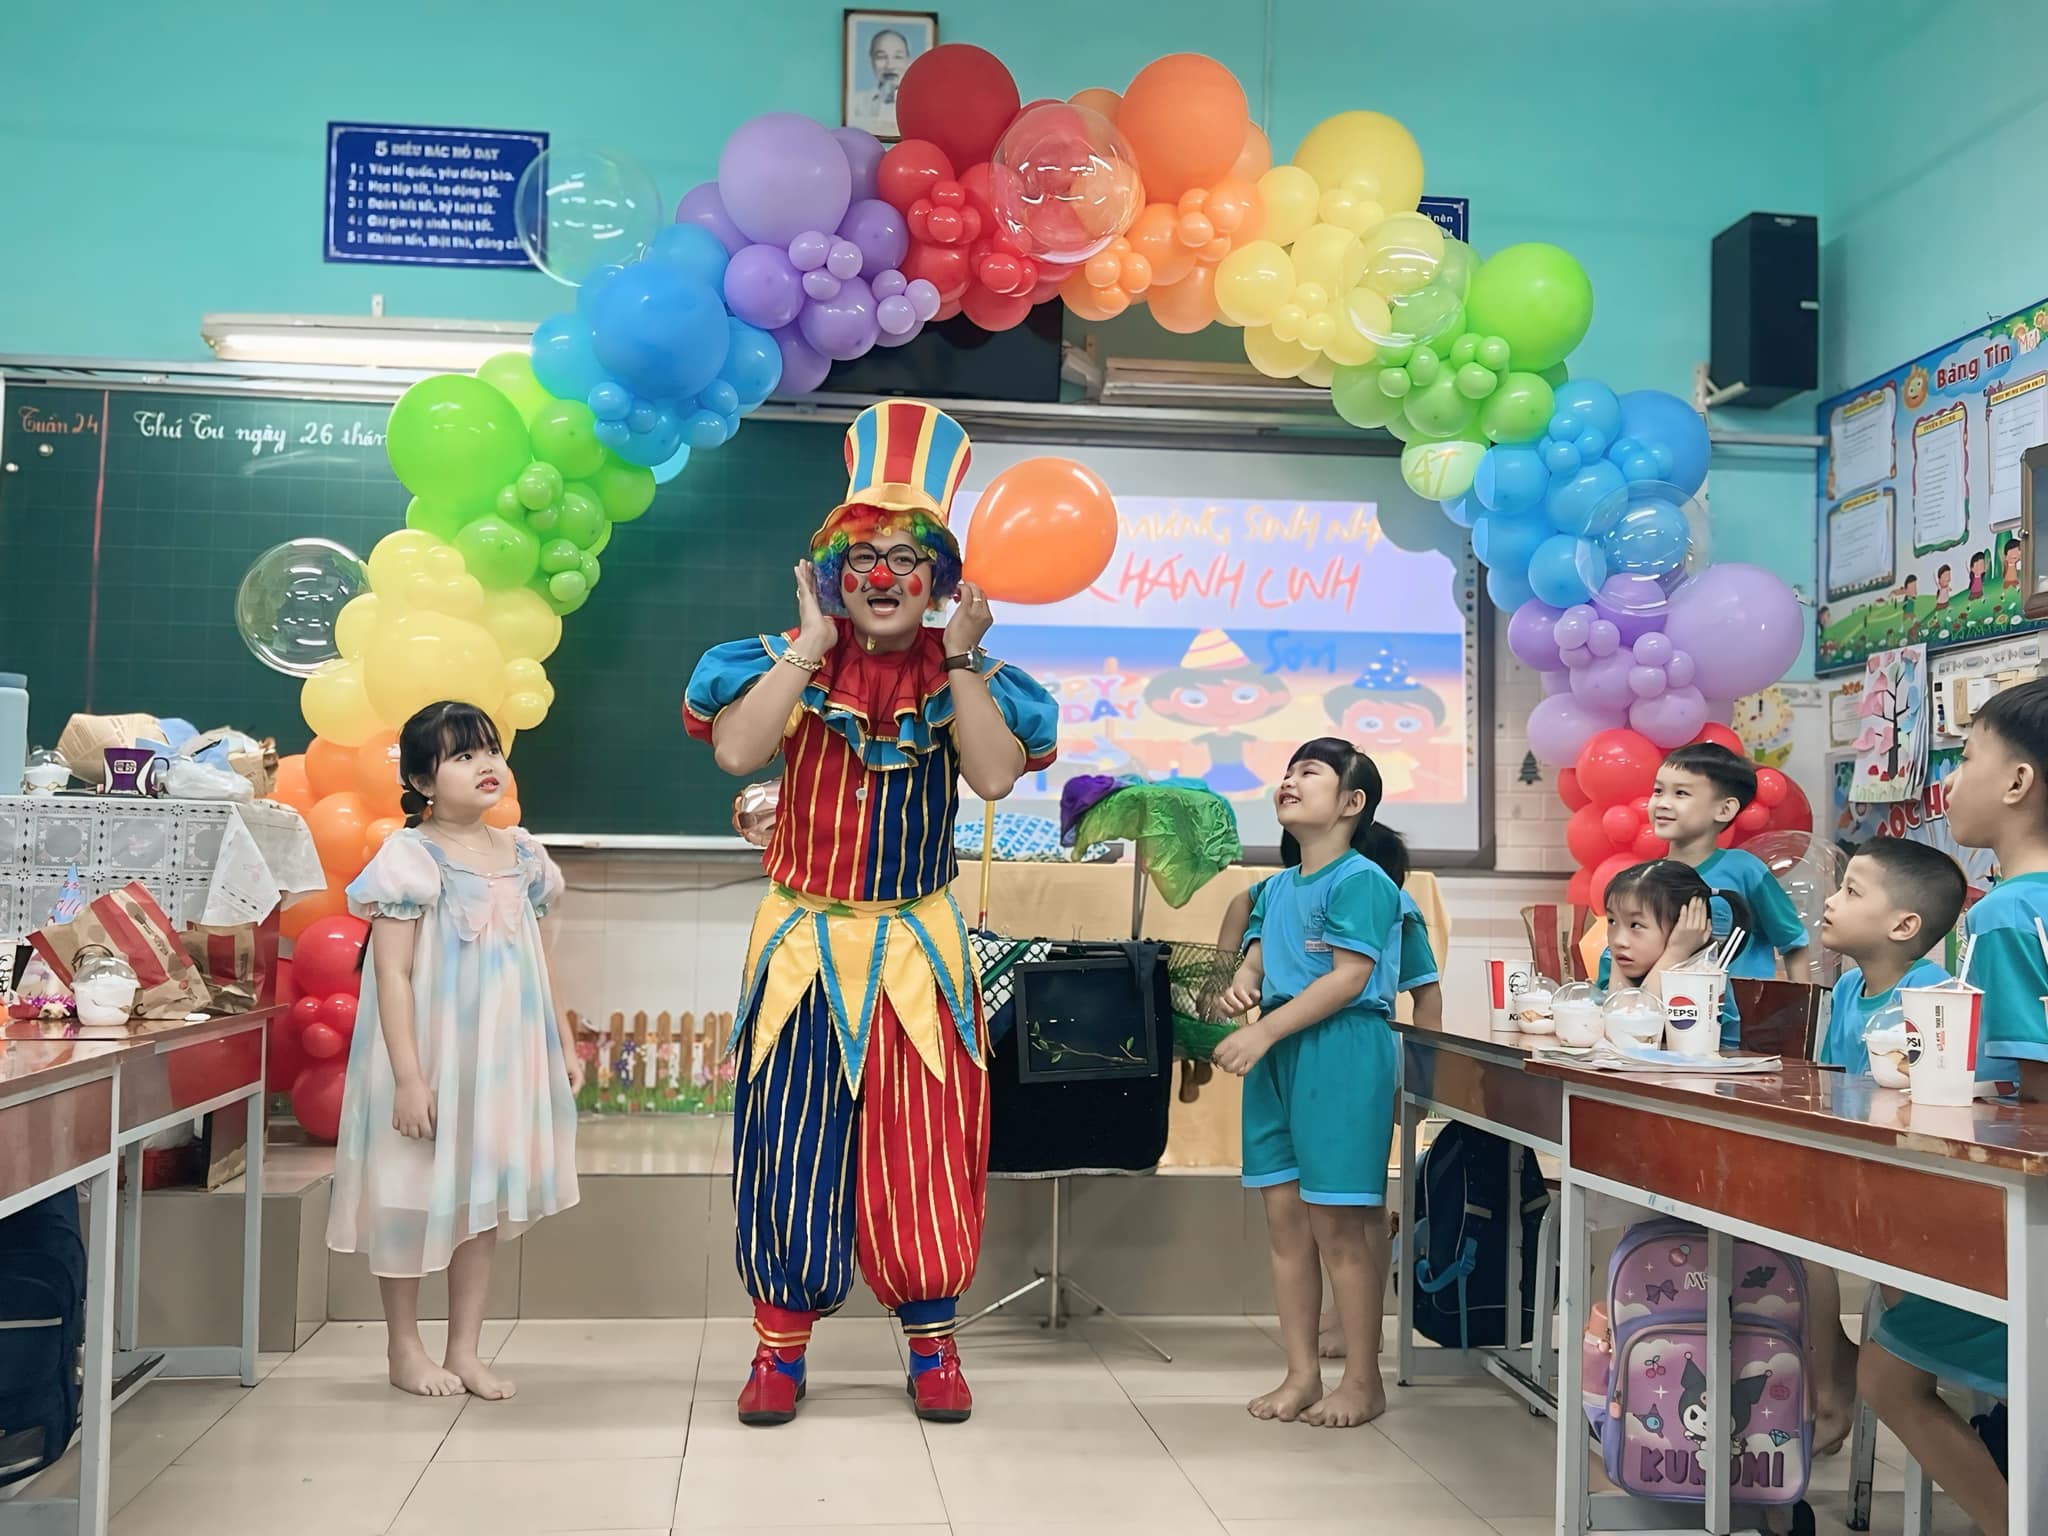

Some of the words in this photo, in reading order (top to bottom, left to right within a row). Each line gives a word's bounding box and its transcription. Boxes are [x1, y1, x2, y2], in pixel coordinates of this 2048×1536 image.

[375, 140, 388, 157] 5
[1983, 343, 2011, 368] Tin
[72, 412, 98, 435] 24
[235, 424, 287, 455] ngày
[299, 421, 334, 445] 26
[1667, 1007, 1698, 1018] PEPSI
[1640, 1447, 1785, 1488] KUMI
